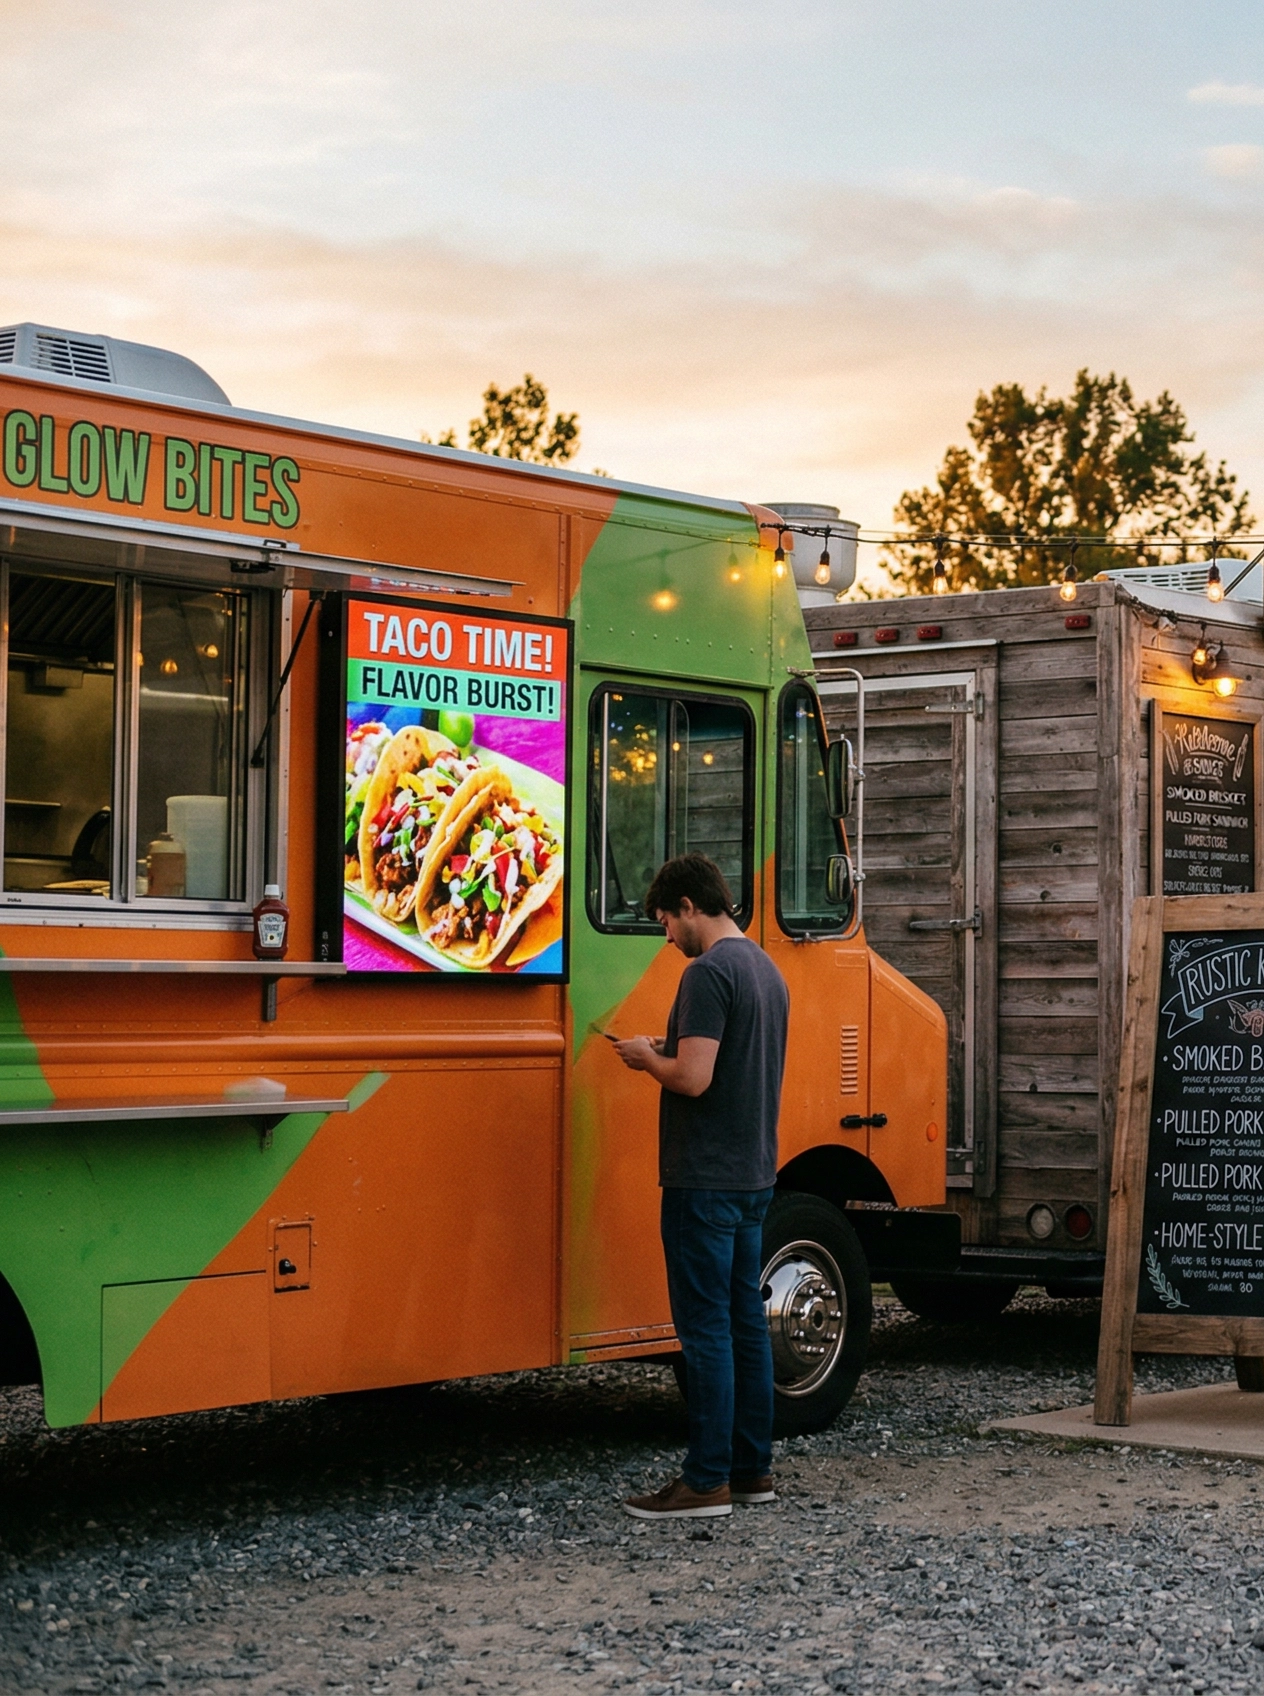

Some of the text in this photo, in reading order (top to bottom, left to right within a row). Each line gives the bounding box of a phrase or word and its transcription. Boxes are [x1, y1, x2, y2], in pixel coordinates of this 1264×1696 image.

[3, 409, 300, 529] GLOW BITES
[363, 611, 553, 673] TACO TIME!
[362, 666, 554, 714] FLAVOR BURST!
[1186, 949, 1251, 1005] RUSTIC
[1172, 1045, 1244, 1071] SMOKED
[1164, 1109, 1221, 1134] PULLED
[1225, 1110, 1264, 1135] PORK
[1161, 1163, 1220, 1188] PULLED
[1224, 1164, 1263, 1190] PORK
[1161, 1222, 1264, 1251] HOME-STYLE
